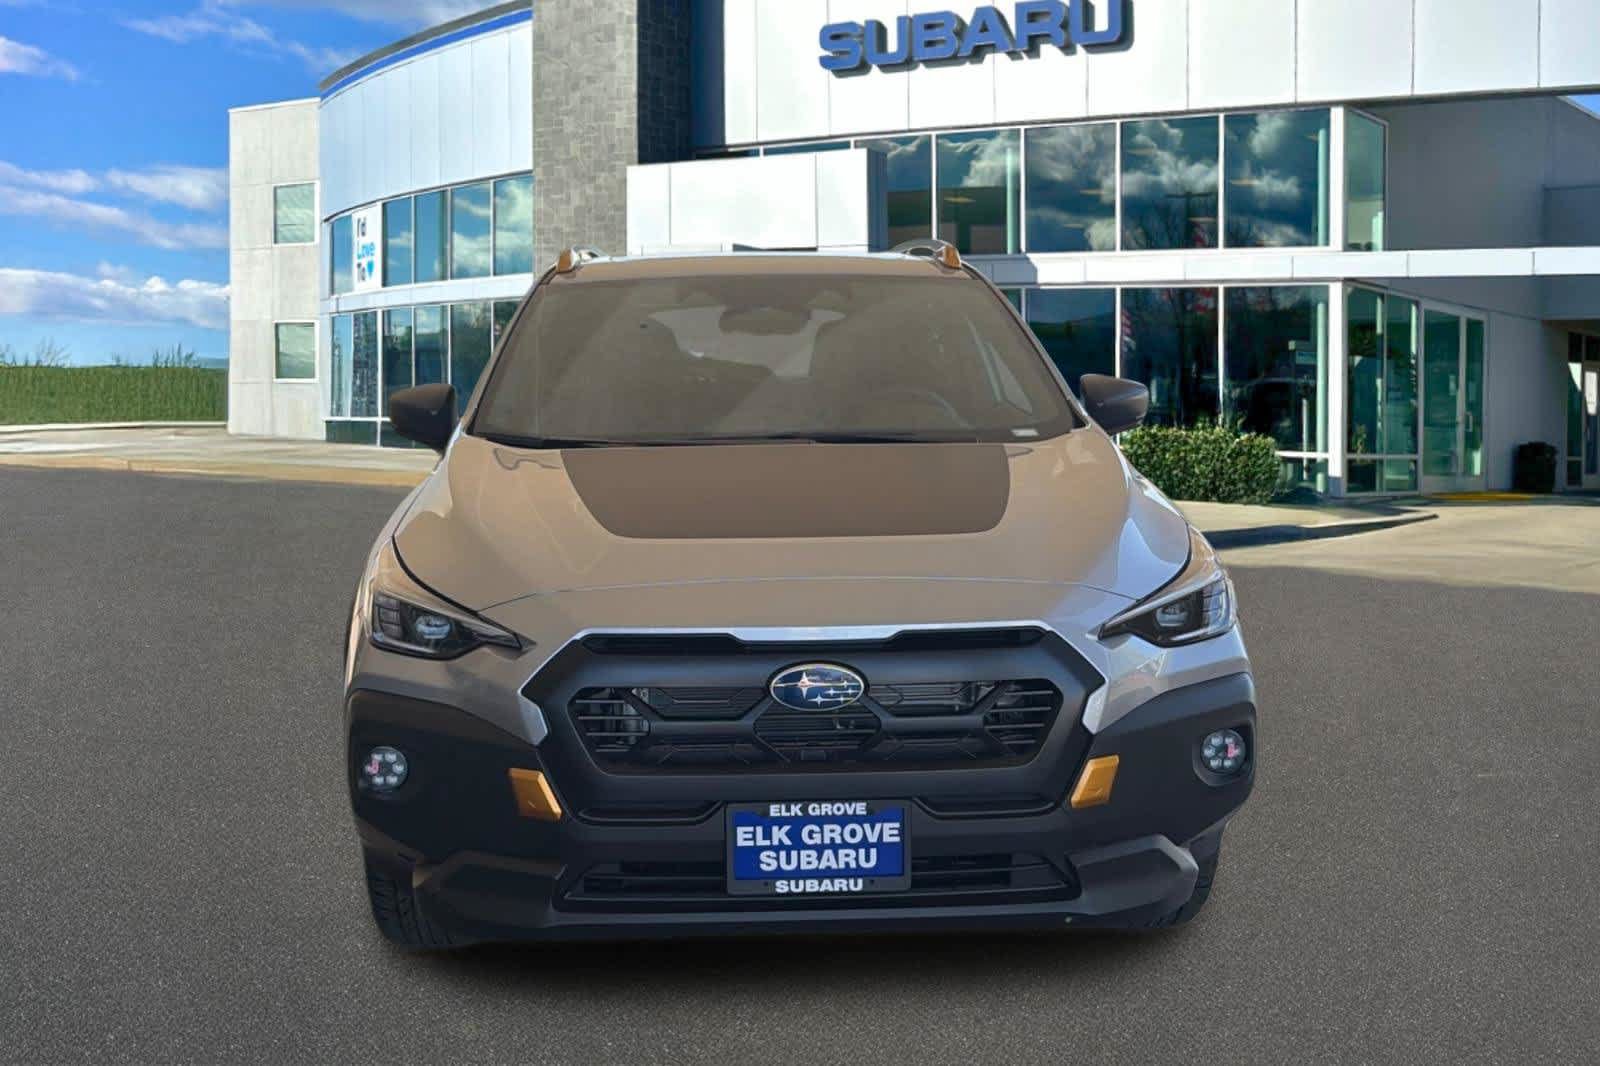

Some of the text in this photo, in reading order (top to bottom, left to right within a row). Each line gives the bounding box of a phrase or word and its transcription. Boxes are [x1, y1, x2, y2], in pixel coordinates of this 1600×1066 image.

[819, 0, 1127, 72] SUBARU
[769, 802, 867, 817] ELK GROVE
[736, 822, 900, 847] ELK GROVE
[759, 848, 877, 872] SUBARU
[775, 878, 864, 893] SUBARU
